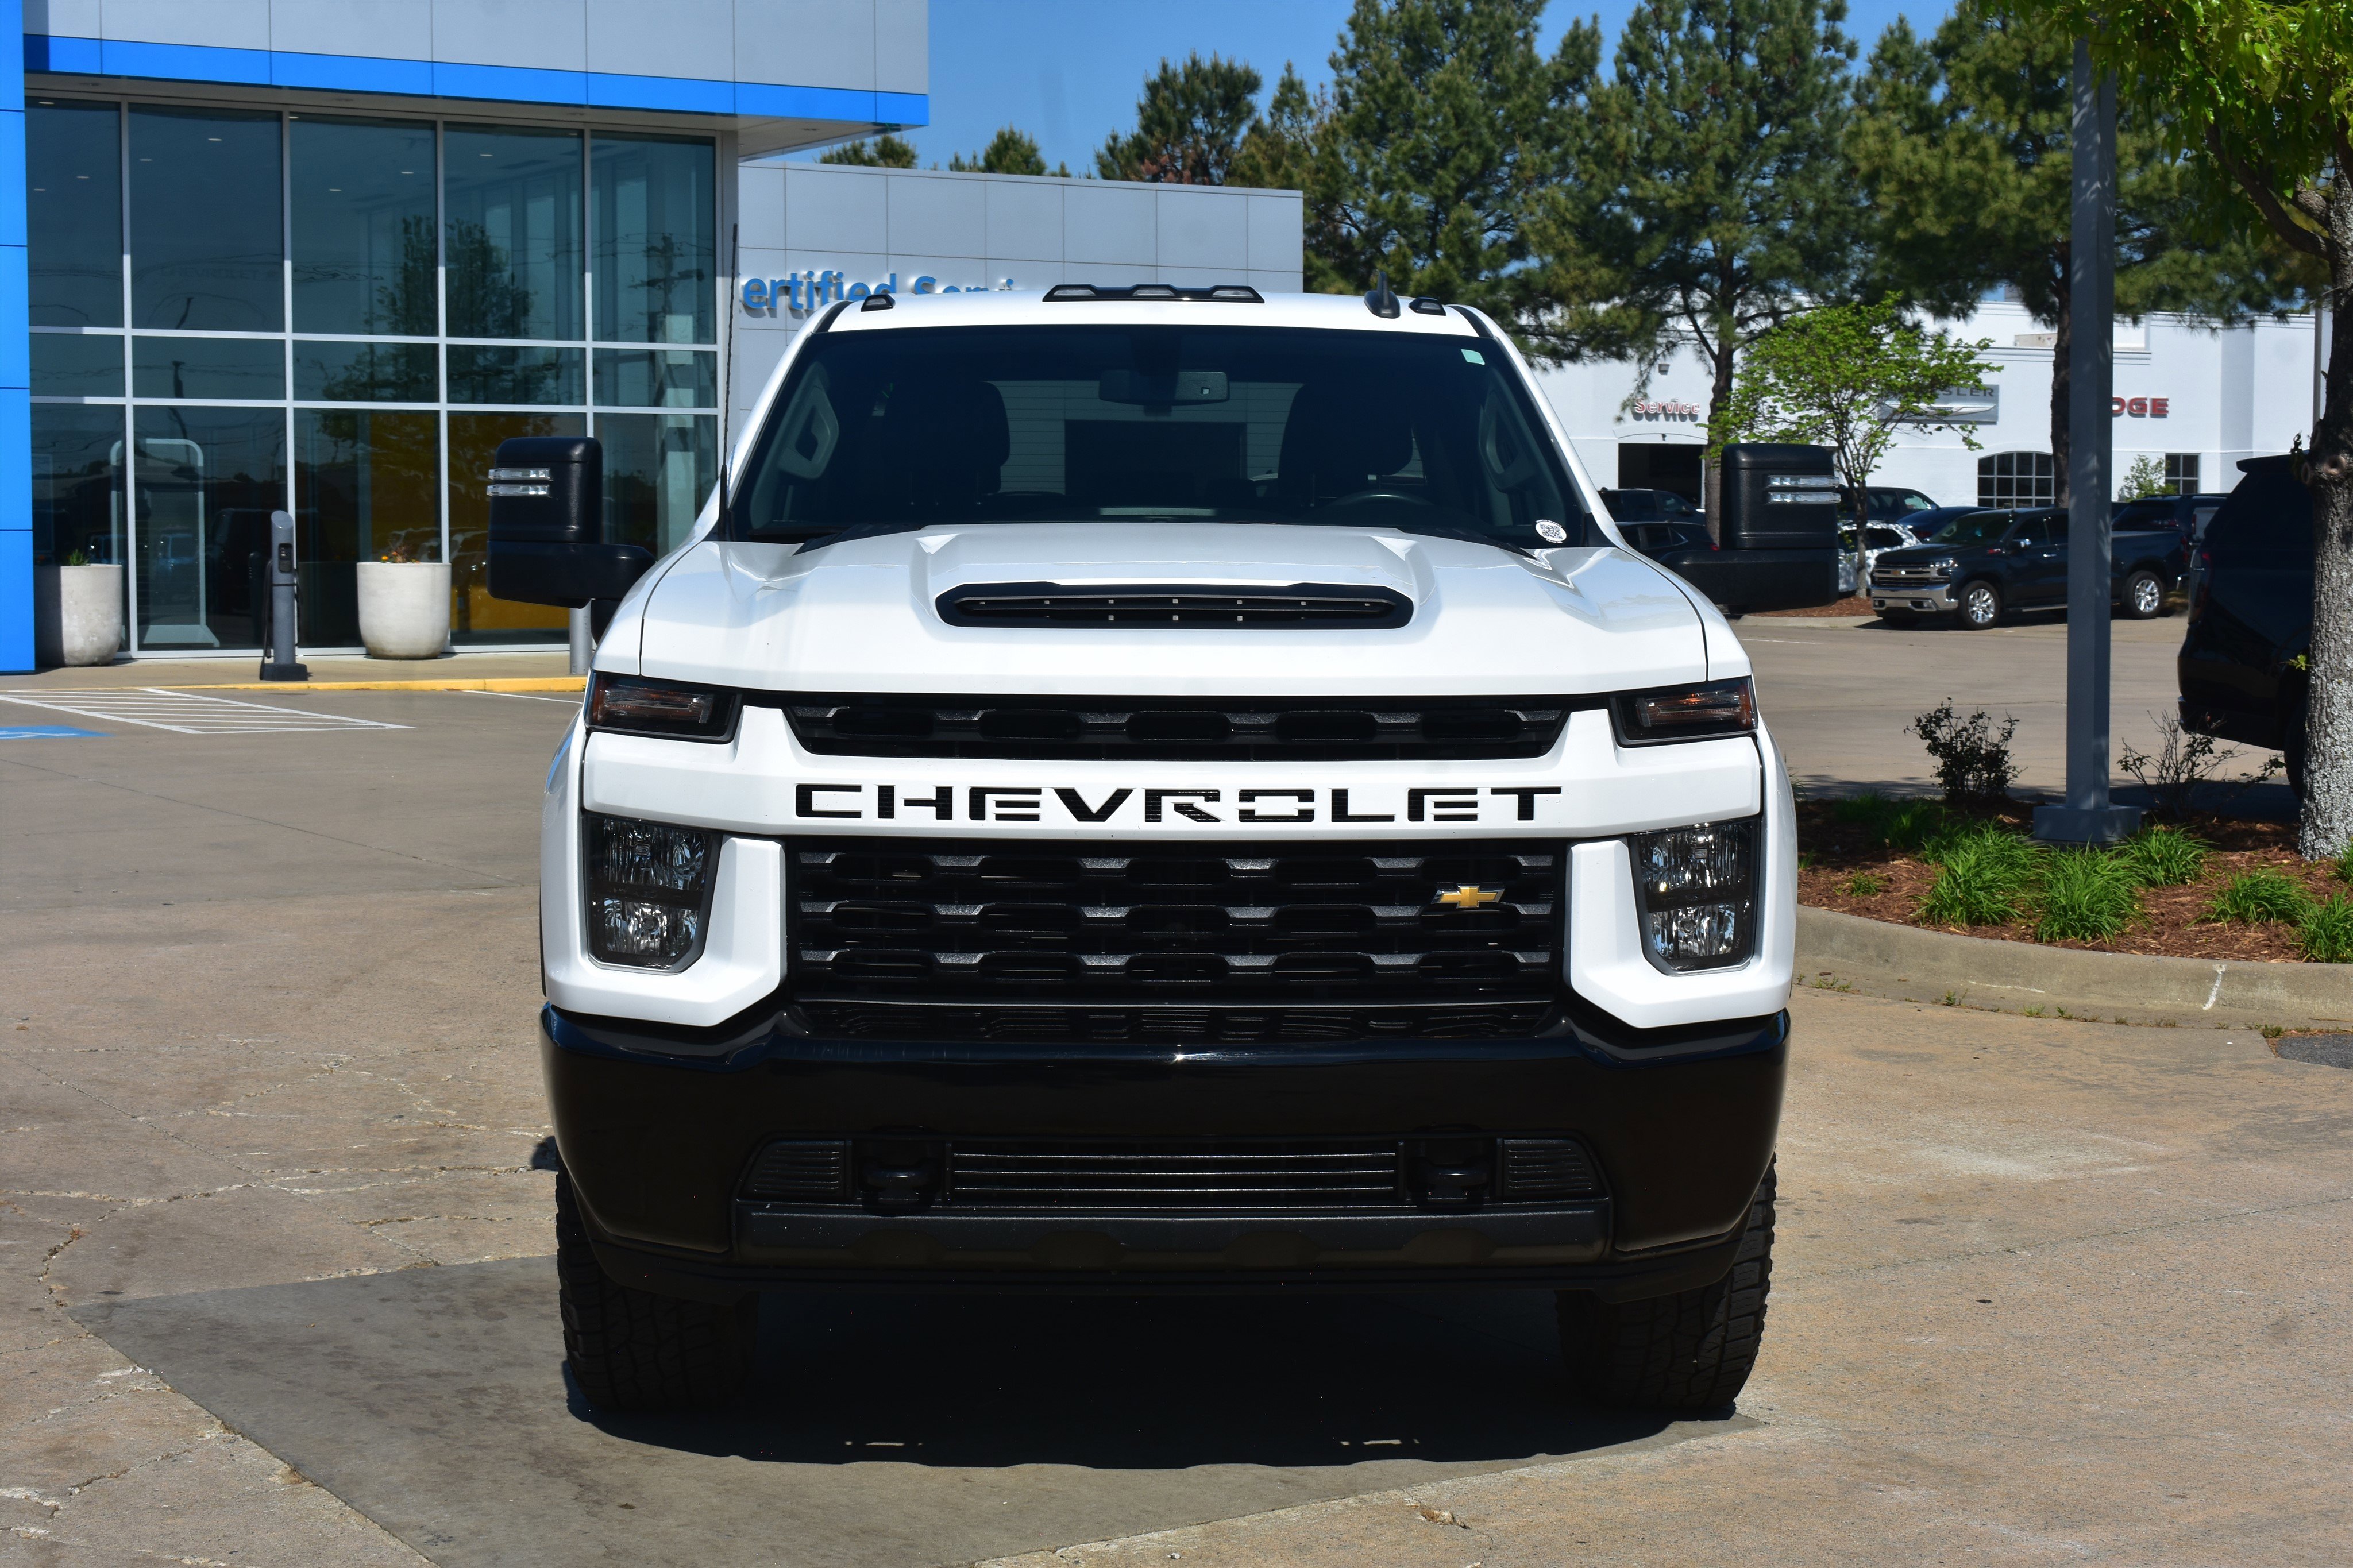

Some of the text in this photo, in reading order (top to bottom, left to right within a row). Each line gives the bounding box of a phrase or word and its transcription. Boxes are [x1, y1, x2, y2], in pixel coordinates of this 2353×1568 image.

[740, 271, 897, 310] ertified
[1942, 386, 1994, 397] SLER
[1634, 397, 1700, 414] Service
[2112, 397, 2169, 414] DGE
[796, 784, 1561, 822] CHEVROLET
